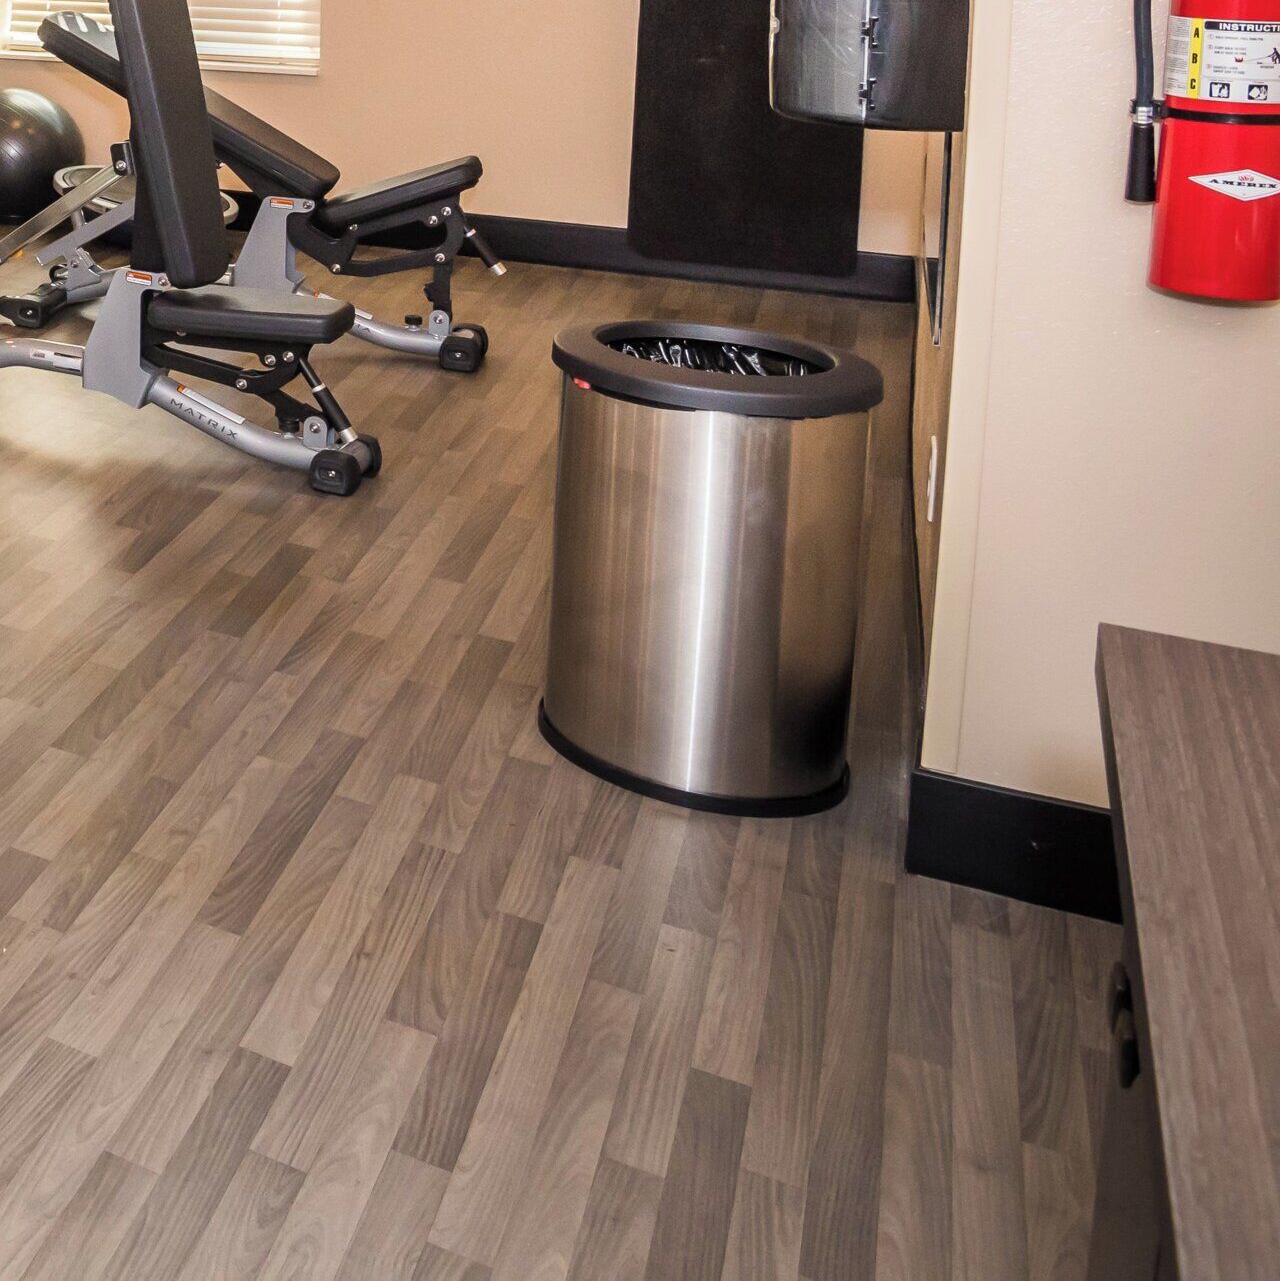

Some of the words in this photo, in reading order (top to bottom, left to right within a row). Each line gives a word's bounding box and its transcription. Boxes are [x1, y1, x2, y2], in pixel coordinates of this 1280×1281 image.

[1194, 28, 1199, 38] A
[1192, 53, 1198, 63] B
[1190, 79, 1196, 89] C
[1209, 179, 1277, 188] AMEREX
[170, 398, 238, 439] MATRIX
